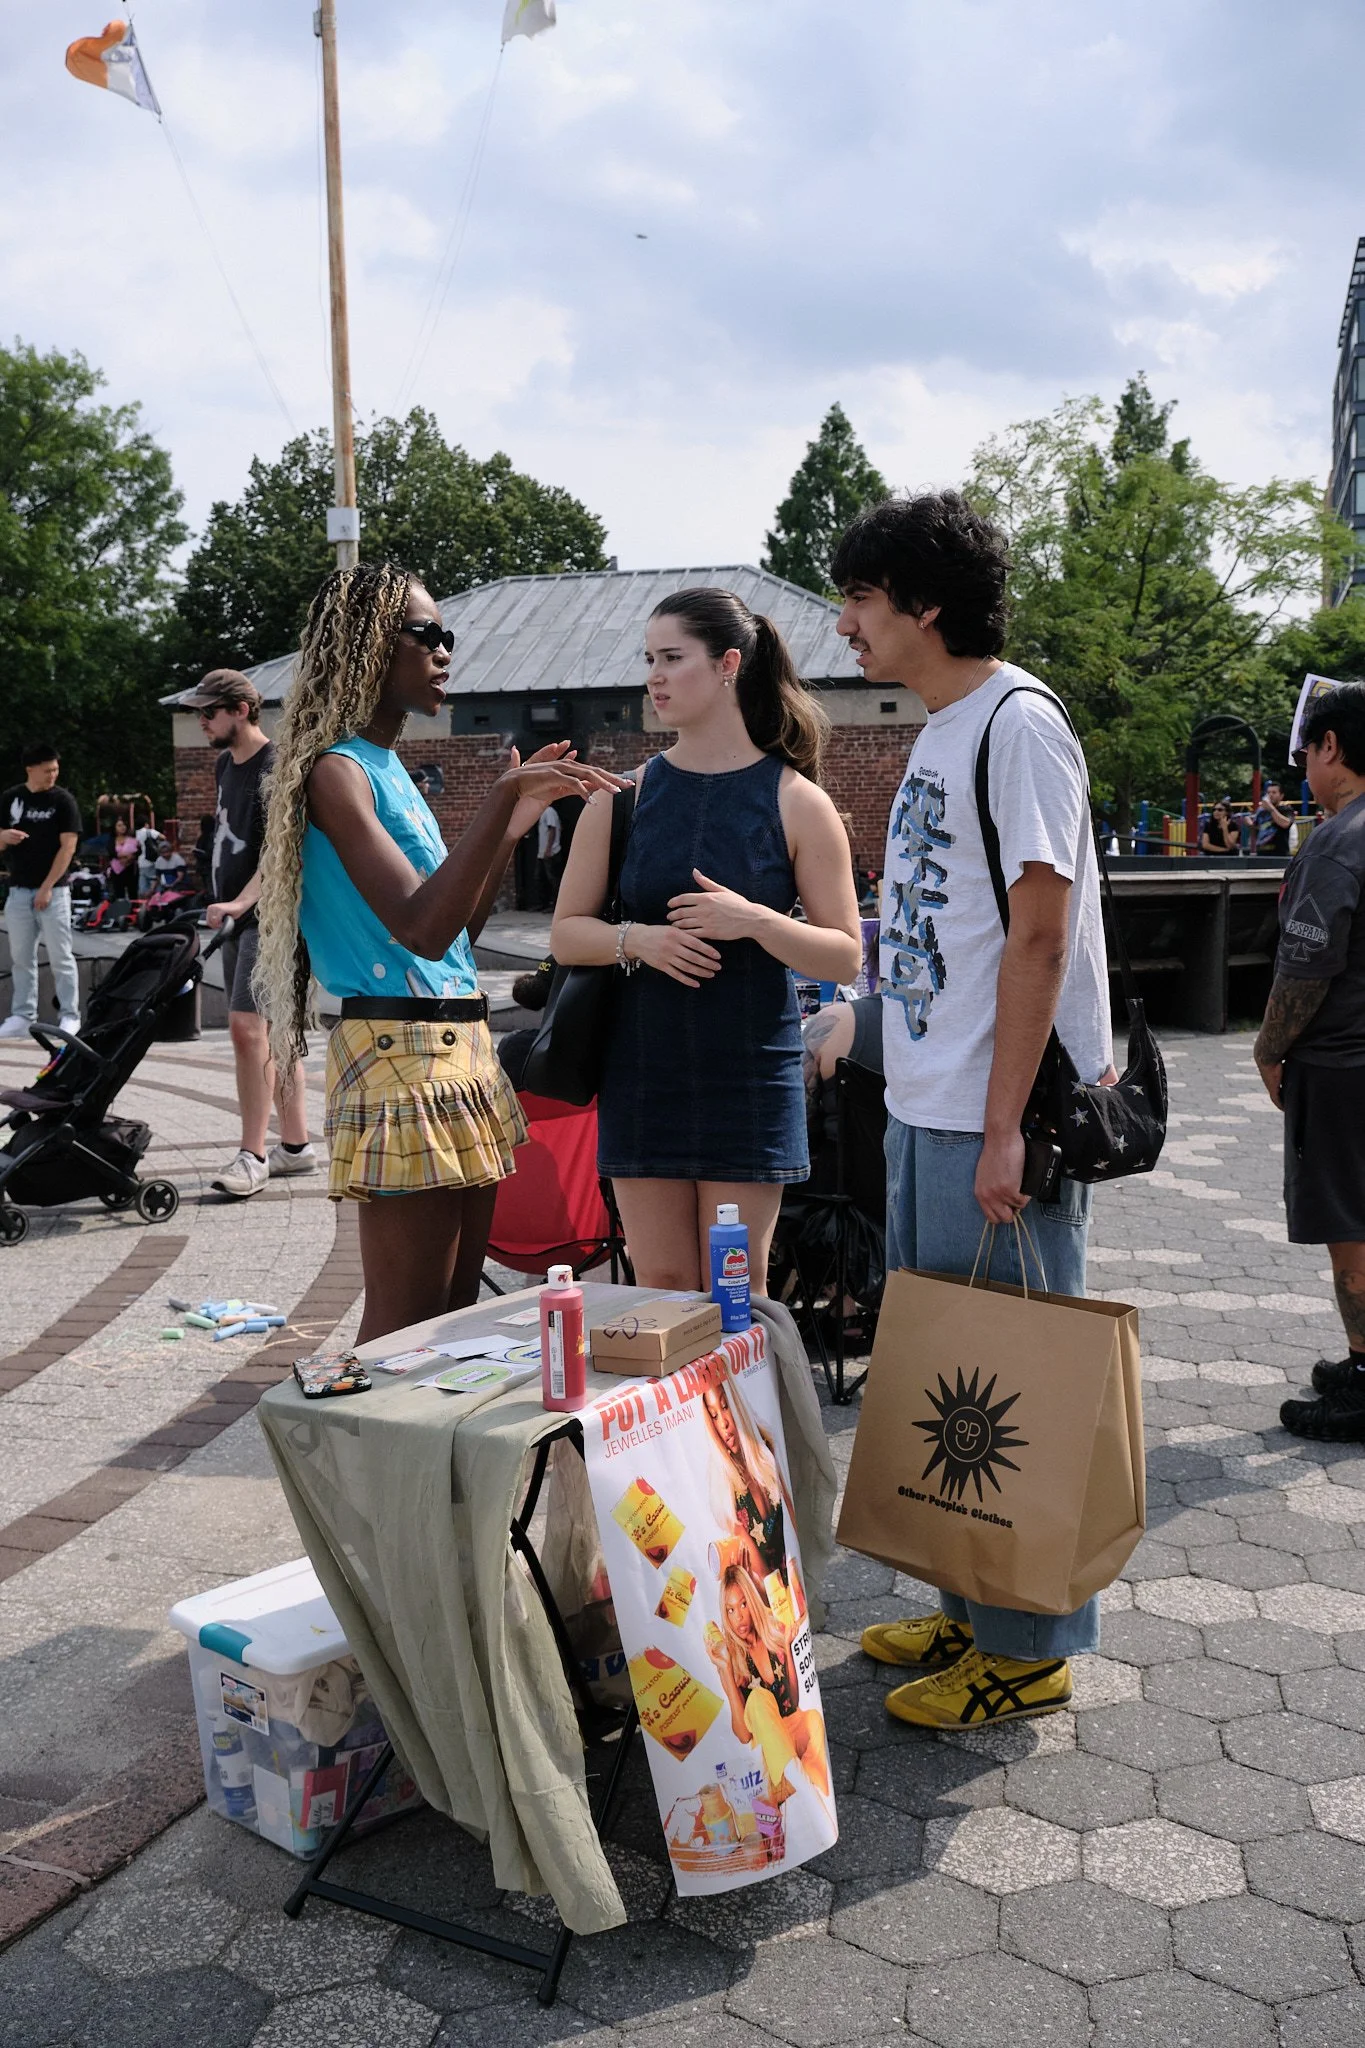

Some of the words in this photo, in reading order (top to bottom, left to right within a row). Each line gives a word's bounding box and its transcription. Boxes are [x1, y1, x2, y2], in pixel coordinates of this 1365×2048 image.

[594, 1386, 646, 1441] PUT
[647, 1377, 673, 1416] A
[669, 1352, 728, 1404] LABEL
[723, 1335, 750, 1376] ON
[748, 1325, 765, 1363] IT
[605, 1420, 663, 1459] JEWELLES
[665, 1405, 694, 1431] IMANI
[898, 1485, 927, 1502] Other
[929, 1494, 968, 1516] People's
[971, 1508, 1013, 1529] Clothes
